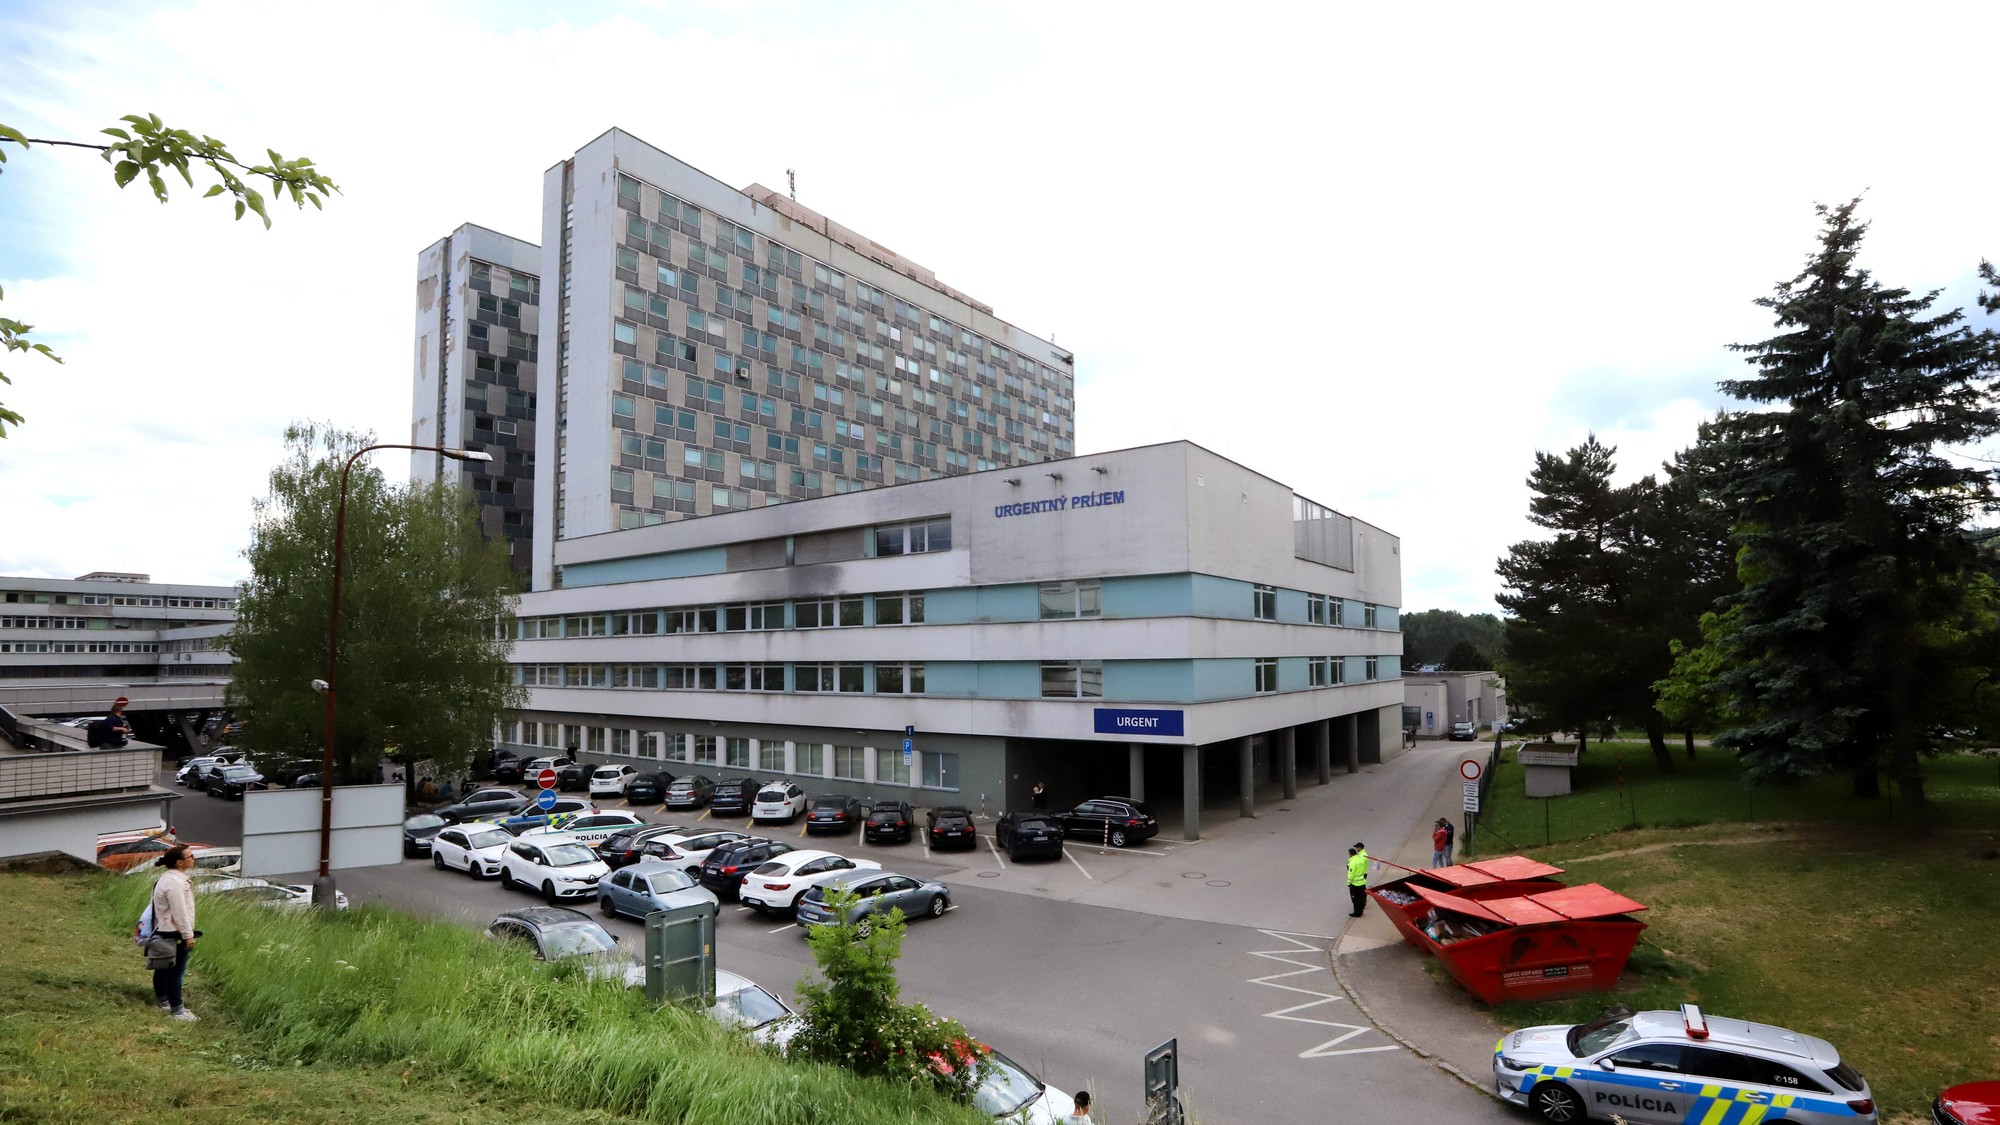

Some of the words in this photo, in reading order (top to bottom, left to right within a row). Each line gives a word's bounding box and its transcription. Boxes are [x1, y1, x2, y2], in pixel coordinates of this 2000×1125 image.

[995, 495, 1067, 518] URGENTNÝ
[1072, 491, 1125, 509] PRÍJEM
[1117, 717, 1159, 728] URGENT
[1783, 1076, 1798, 1085] 158
[1595, 1091, 1677, 1114] POLÍCIA
